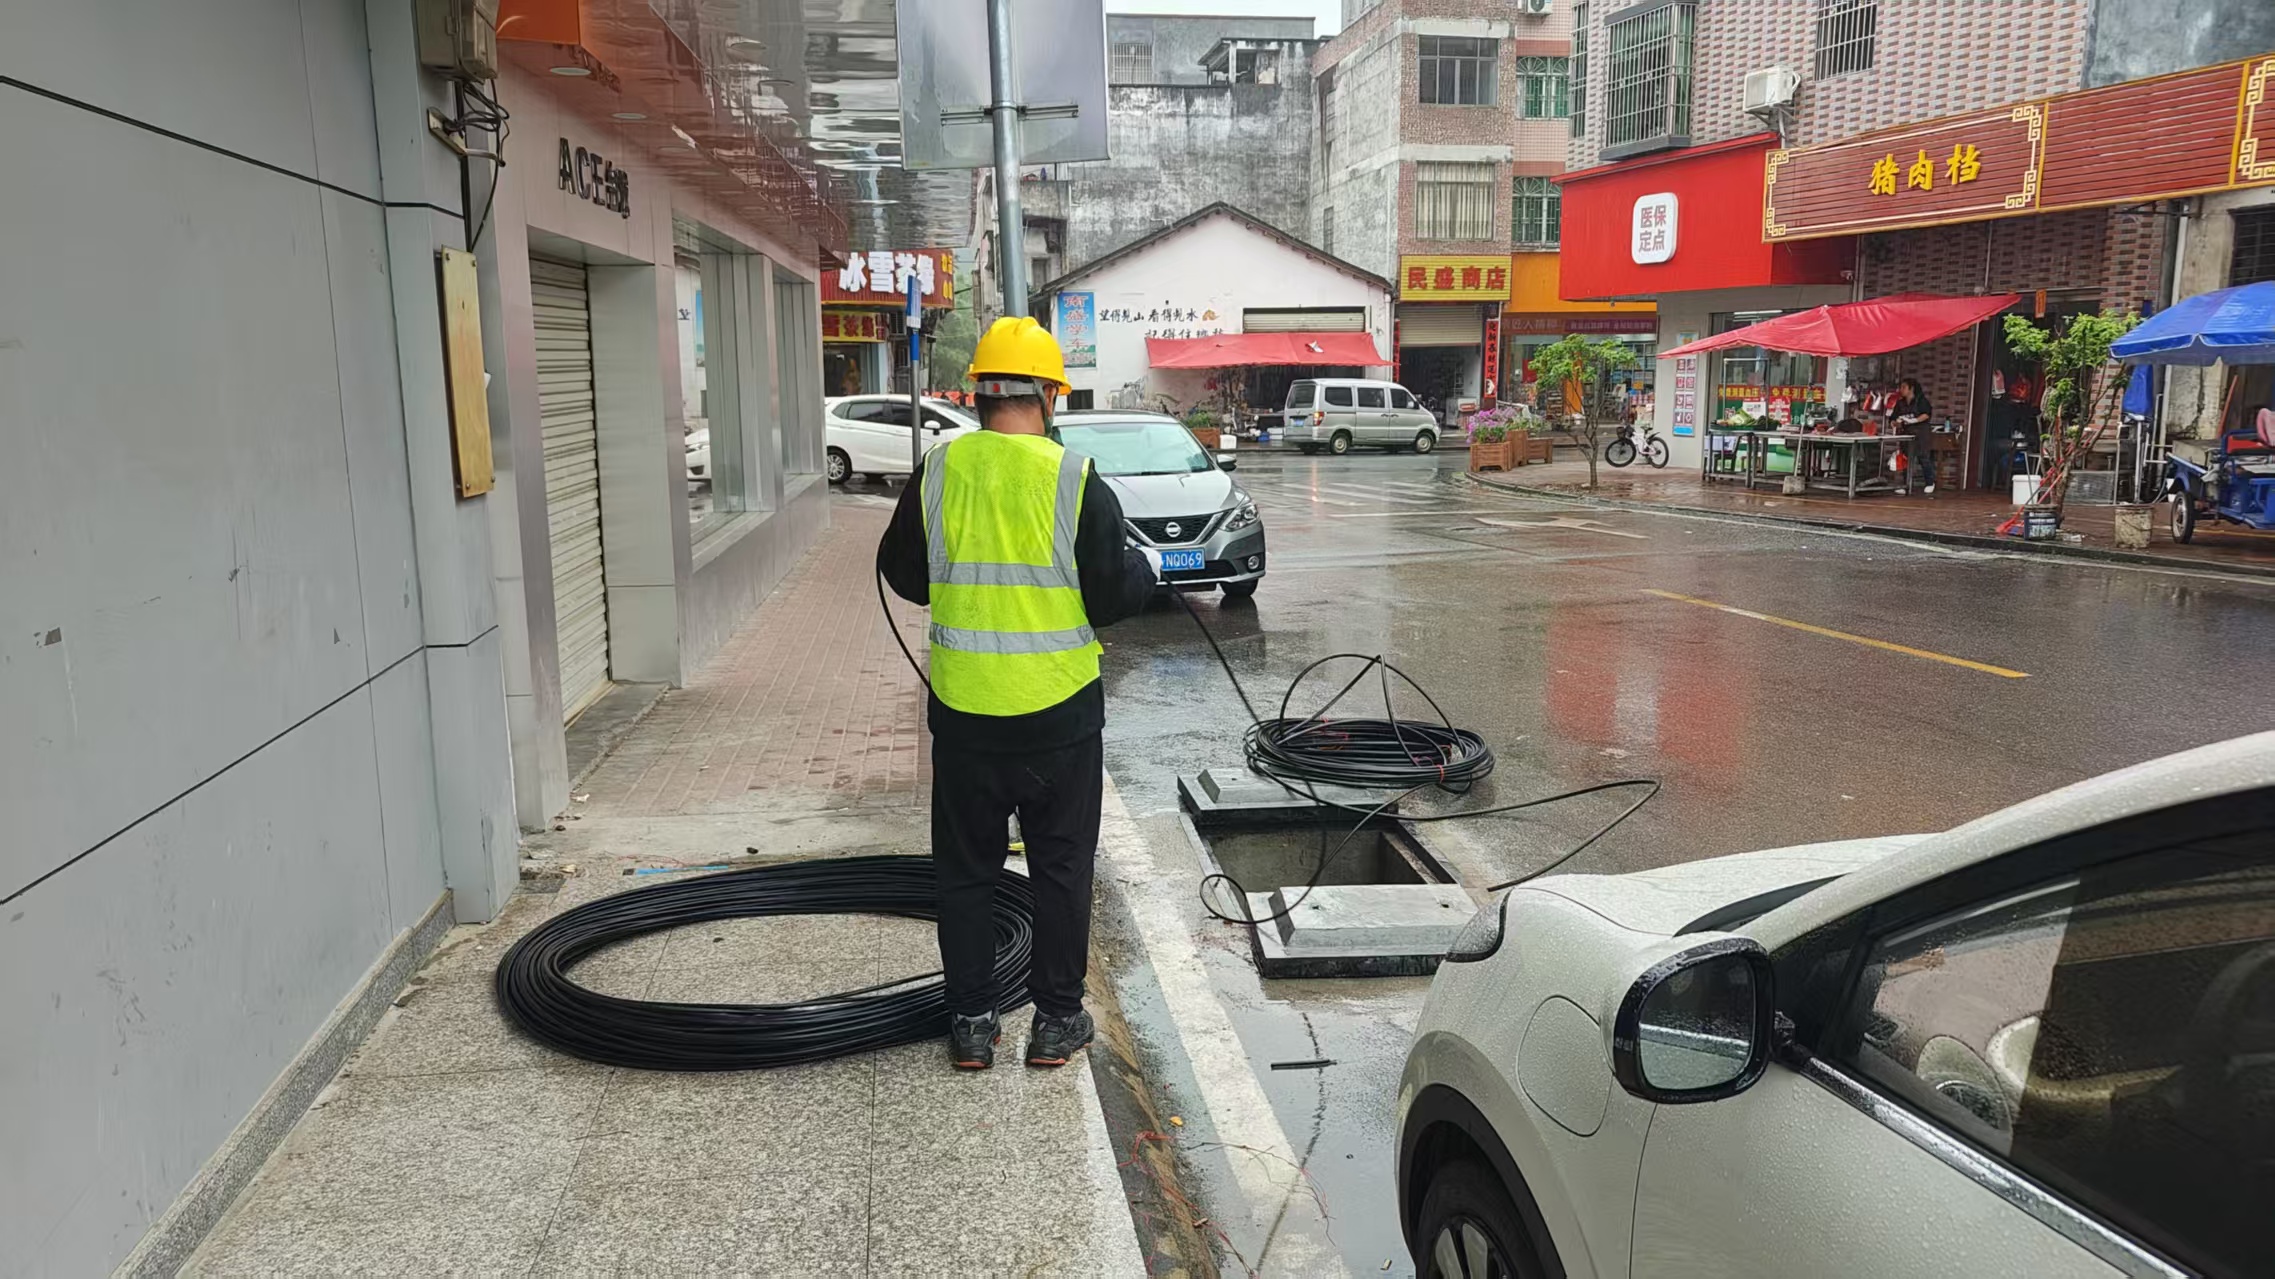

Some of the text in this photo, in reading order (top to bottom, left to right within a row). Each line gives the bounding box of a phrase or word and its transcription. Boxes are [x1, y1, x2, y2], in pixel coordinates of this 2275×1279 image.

[1868, 143, 1981, 196] 猪肉档
[1640, 204, 1667, 228] 医保
[1639, 229, 1665, 253] 定点
[1407, 266, 1507, 291] 民盛商店
